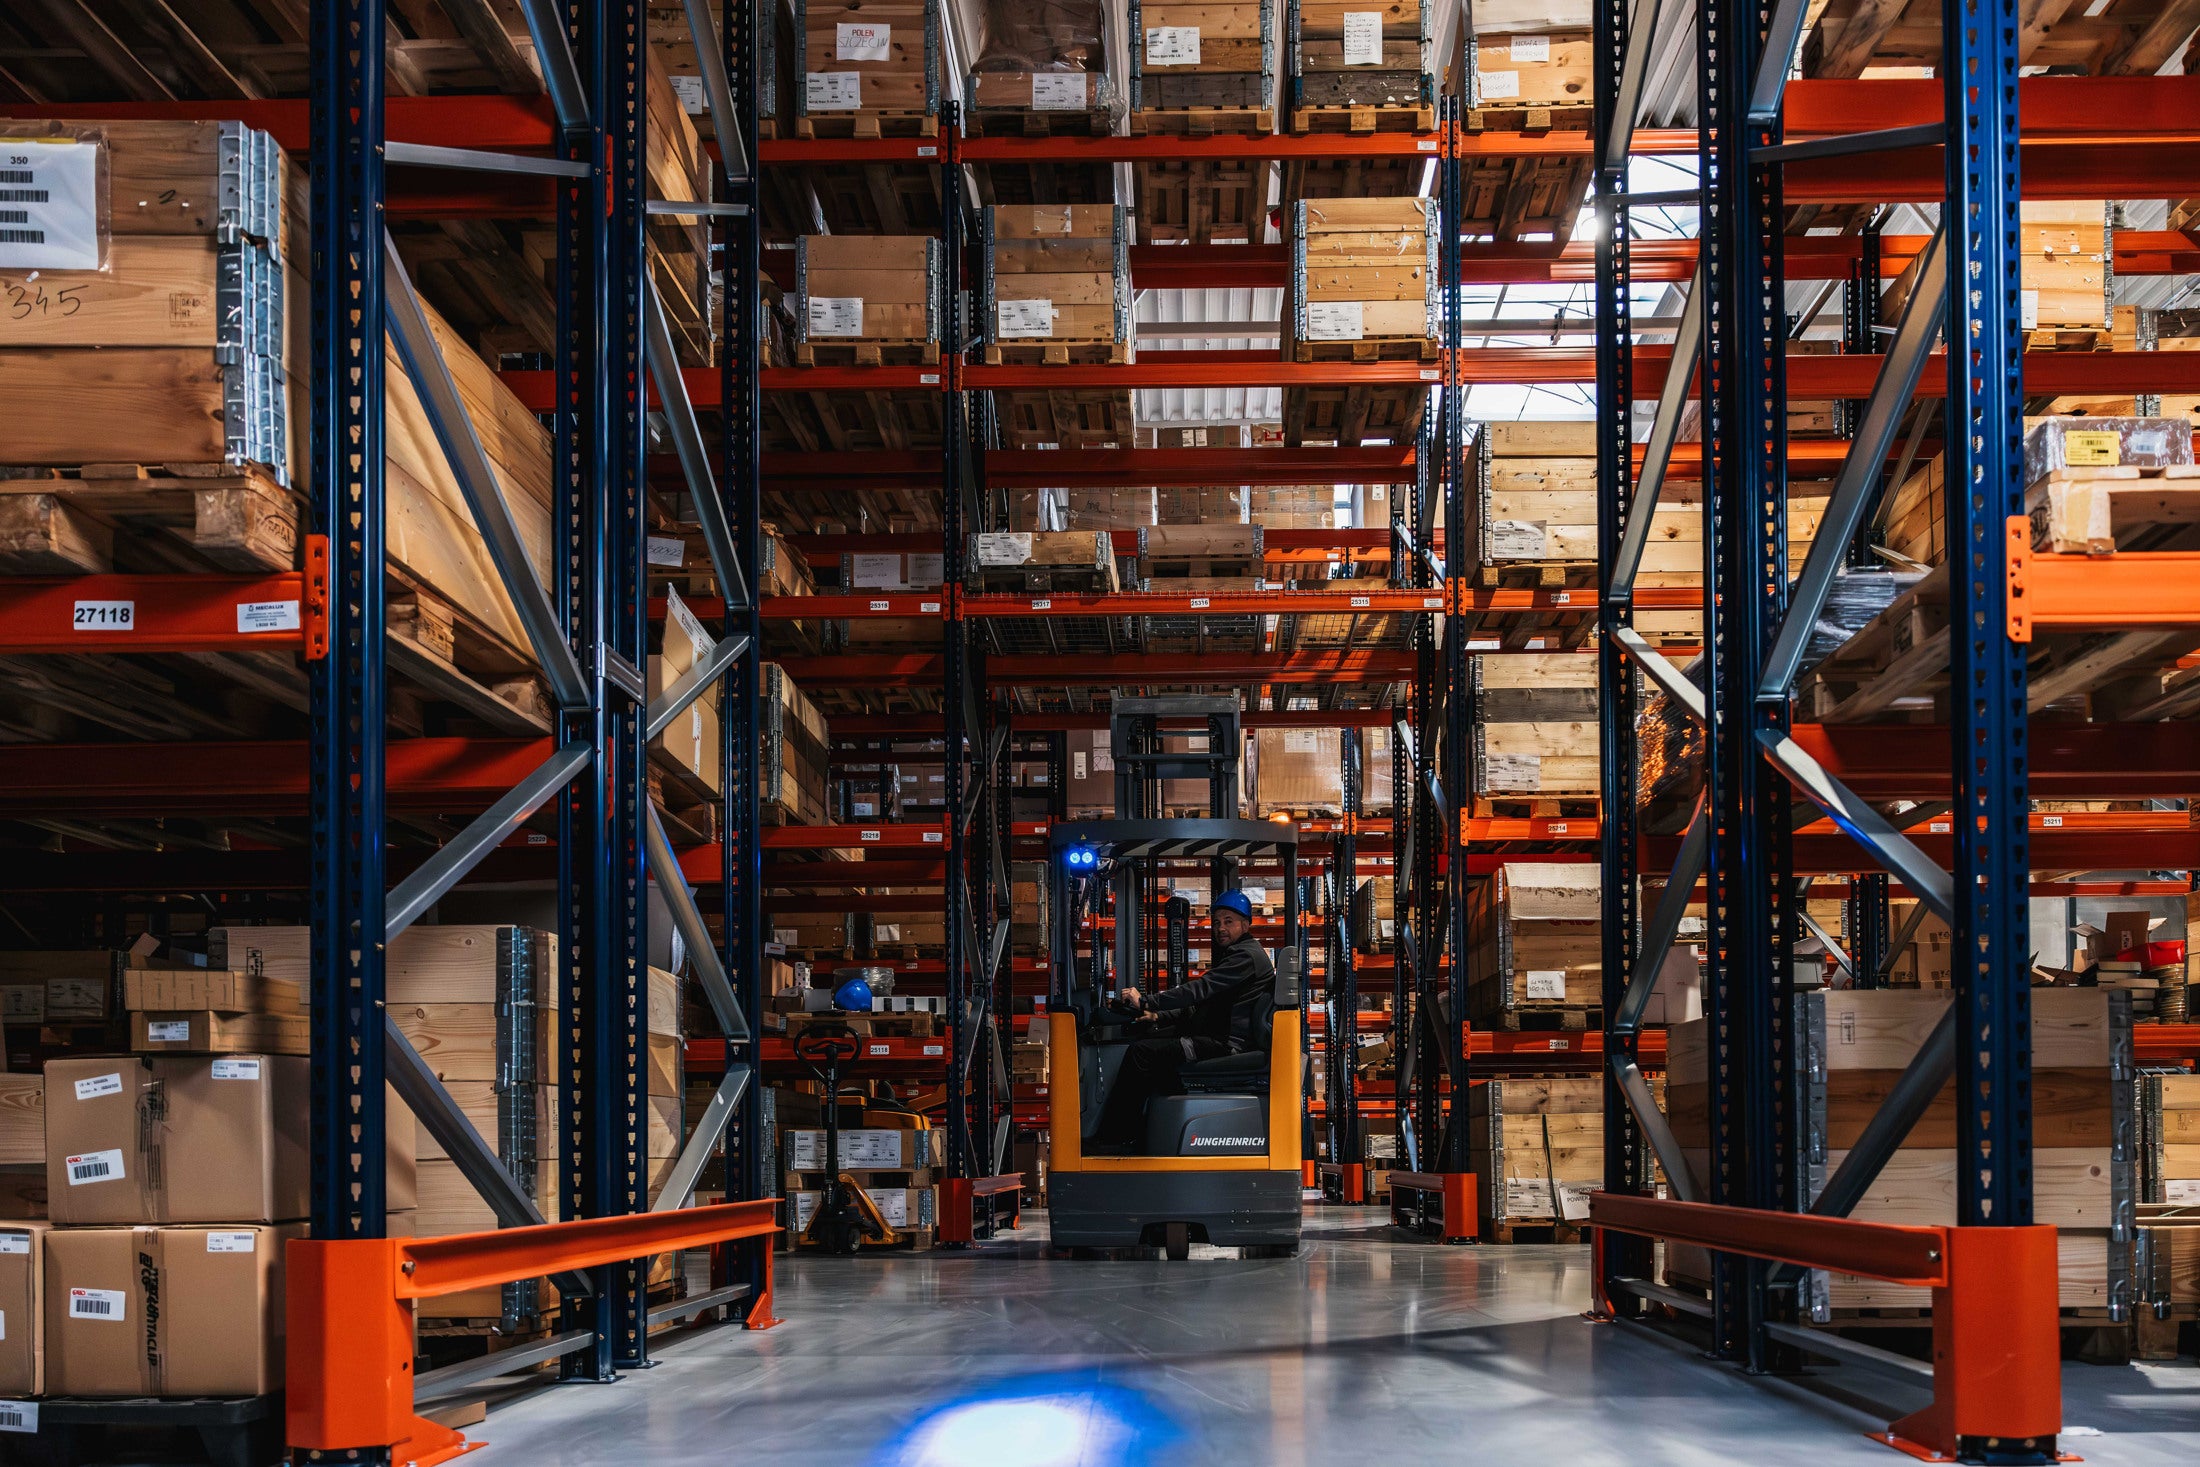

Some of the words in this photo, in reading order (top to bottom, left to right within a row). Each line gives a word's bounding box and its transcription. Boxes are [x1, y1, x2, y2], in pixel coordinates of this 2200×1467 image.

[852, 29, 875, 37] POLEN
[10, 156, 29, 165] 350
[7, 285, 89, 320] 345
[75, 607, 130, 623] 27118
[1190, 1134, 1265, 1146] JUNGHEINRICH
